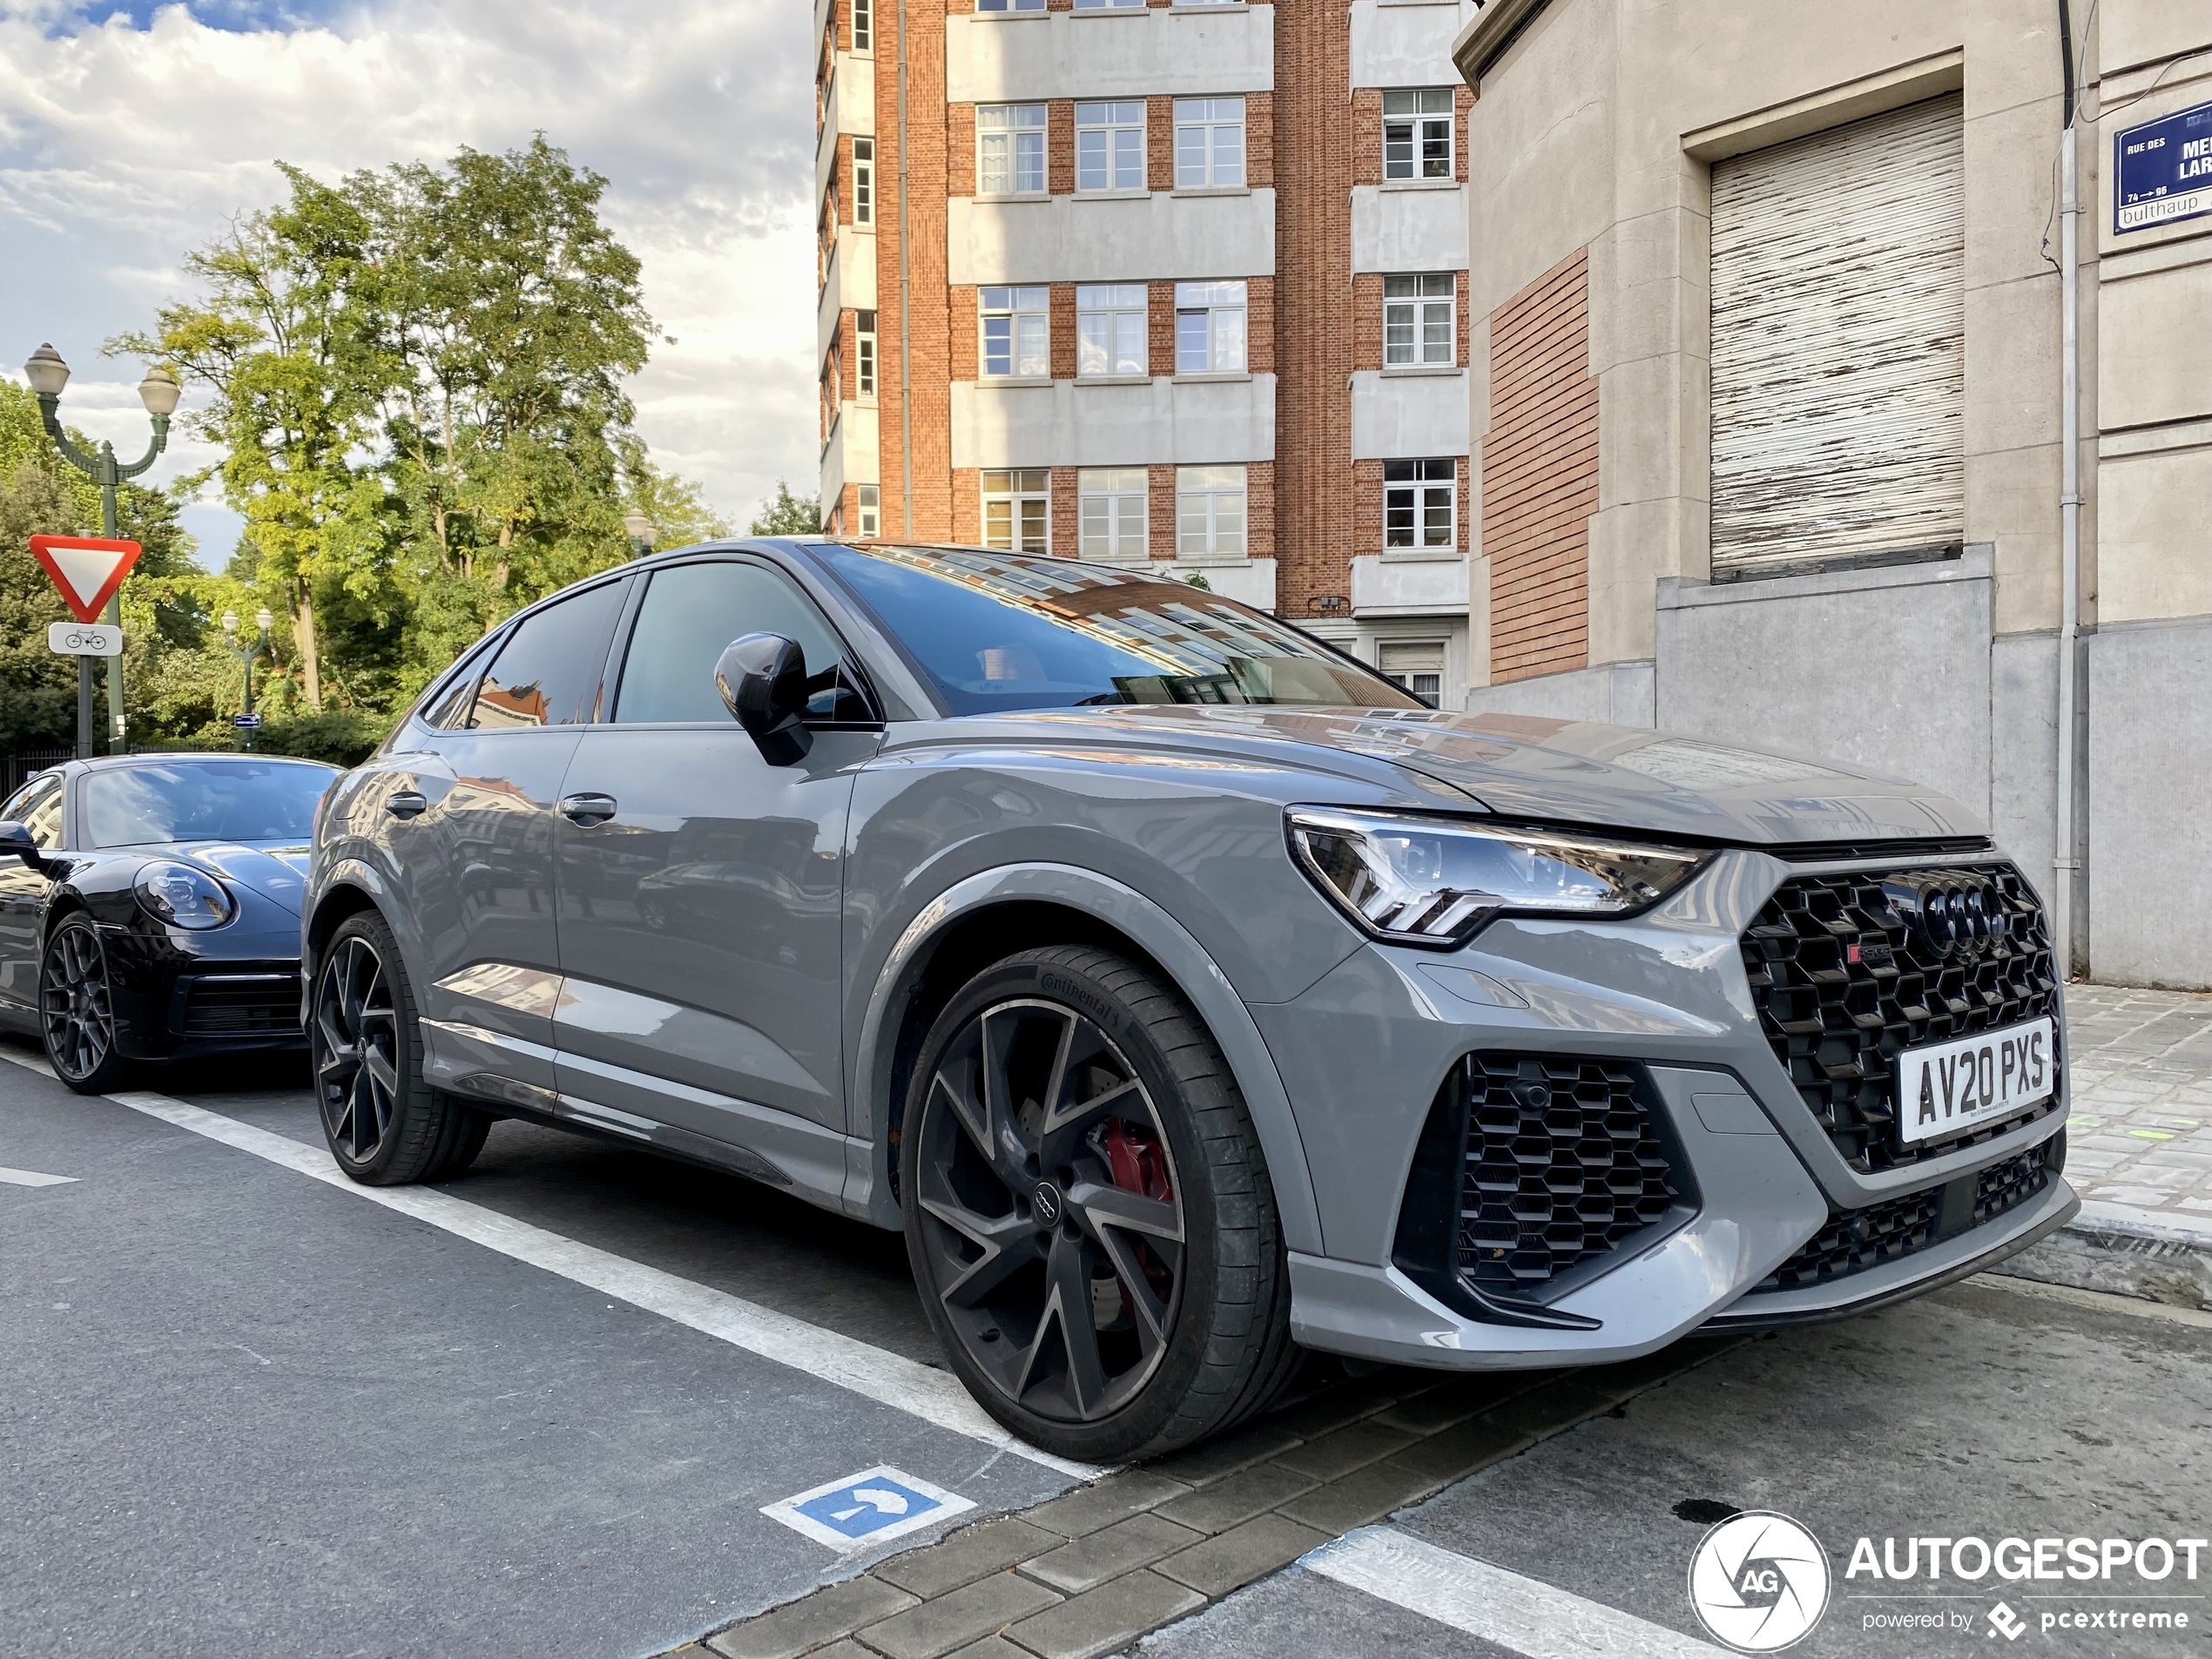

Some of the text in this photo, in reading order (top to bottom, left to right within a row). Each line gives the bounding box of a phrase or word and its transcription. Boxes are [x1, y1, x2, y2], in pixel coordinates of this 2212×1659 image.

[2128, 137, 2166, 155] RUE DES
[2183, 137, 2212, 159] ME
[2128, 185, 2168, 203] 74 96
[2123, 196, 2198, 224] bulthaup
[1041, 973, 1112, 1020] Continental
[1919, 1031, 2043, 1125] AV20 PXS
